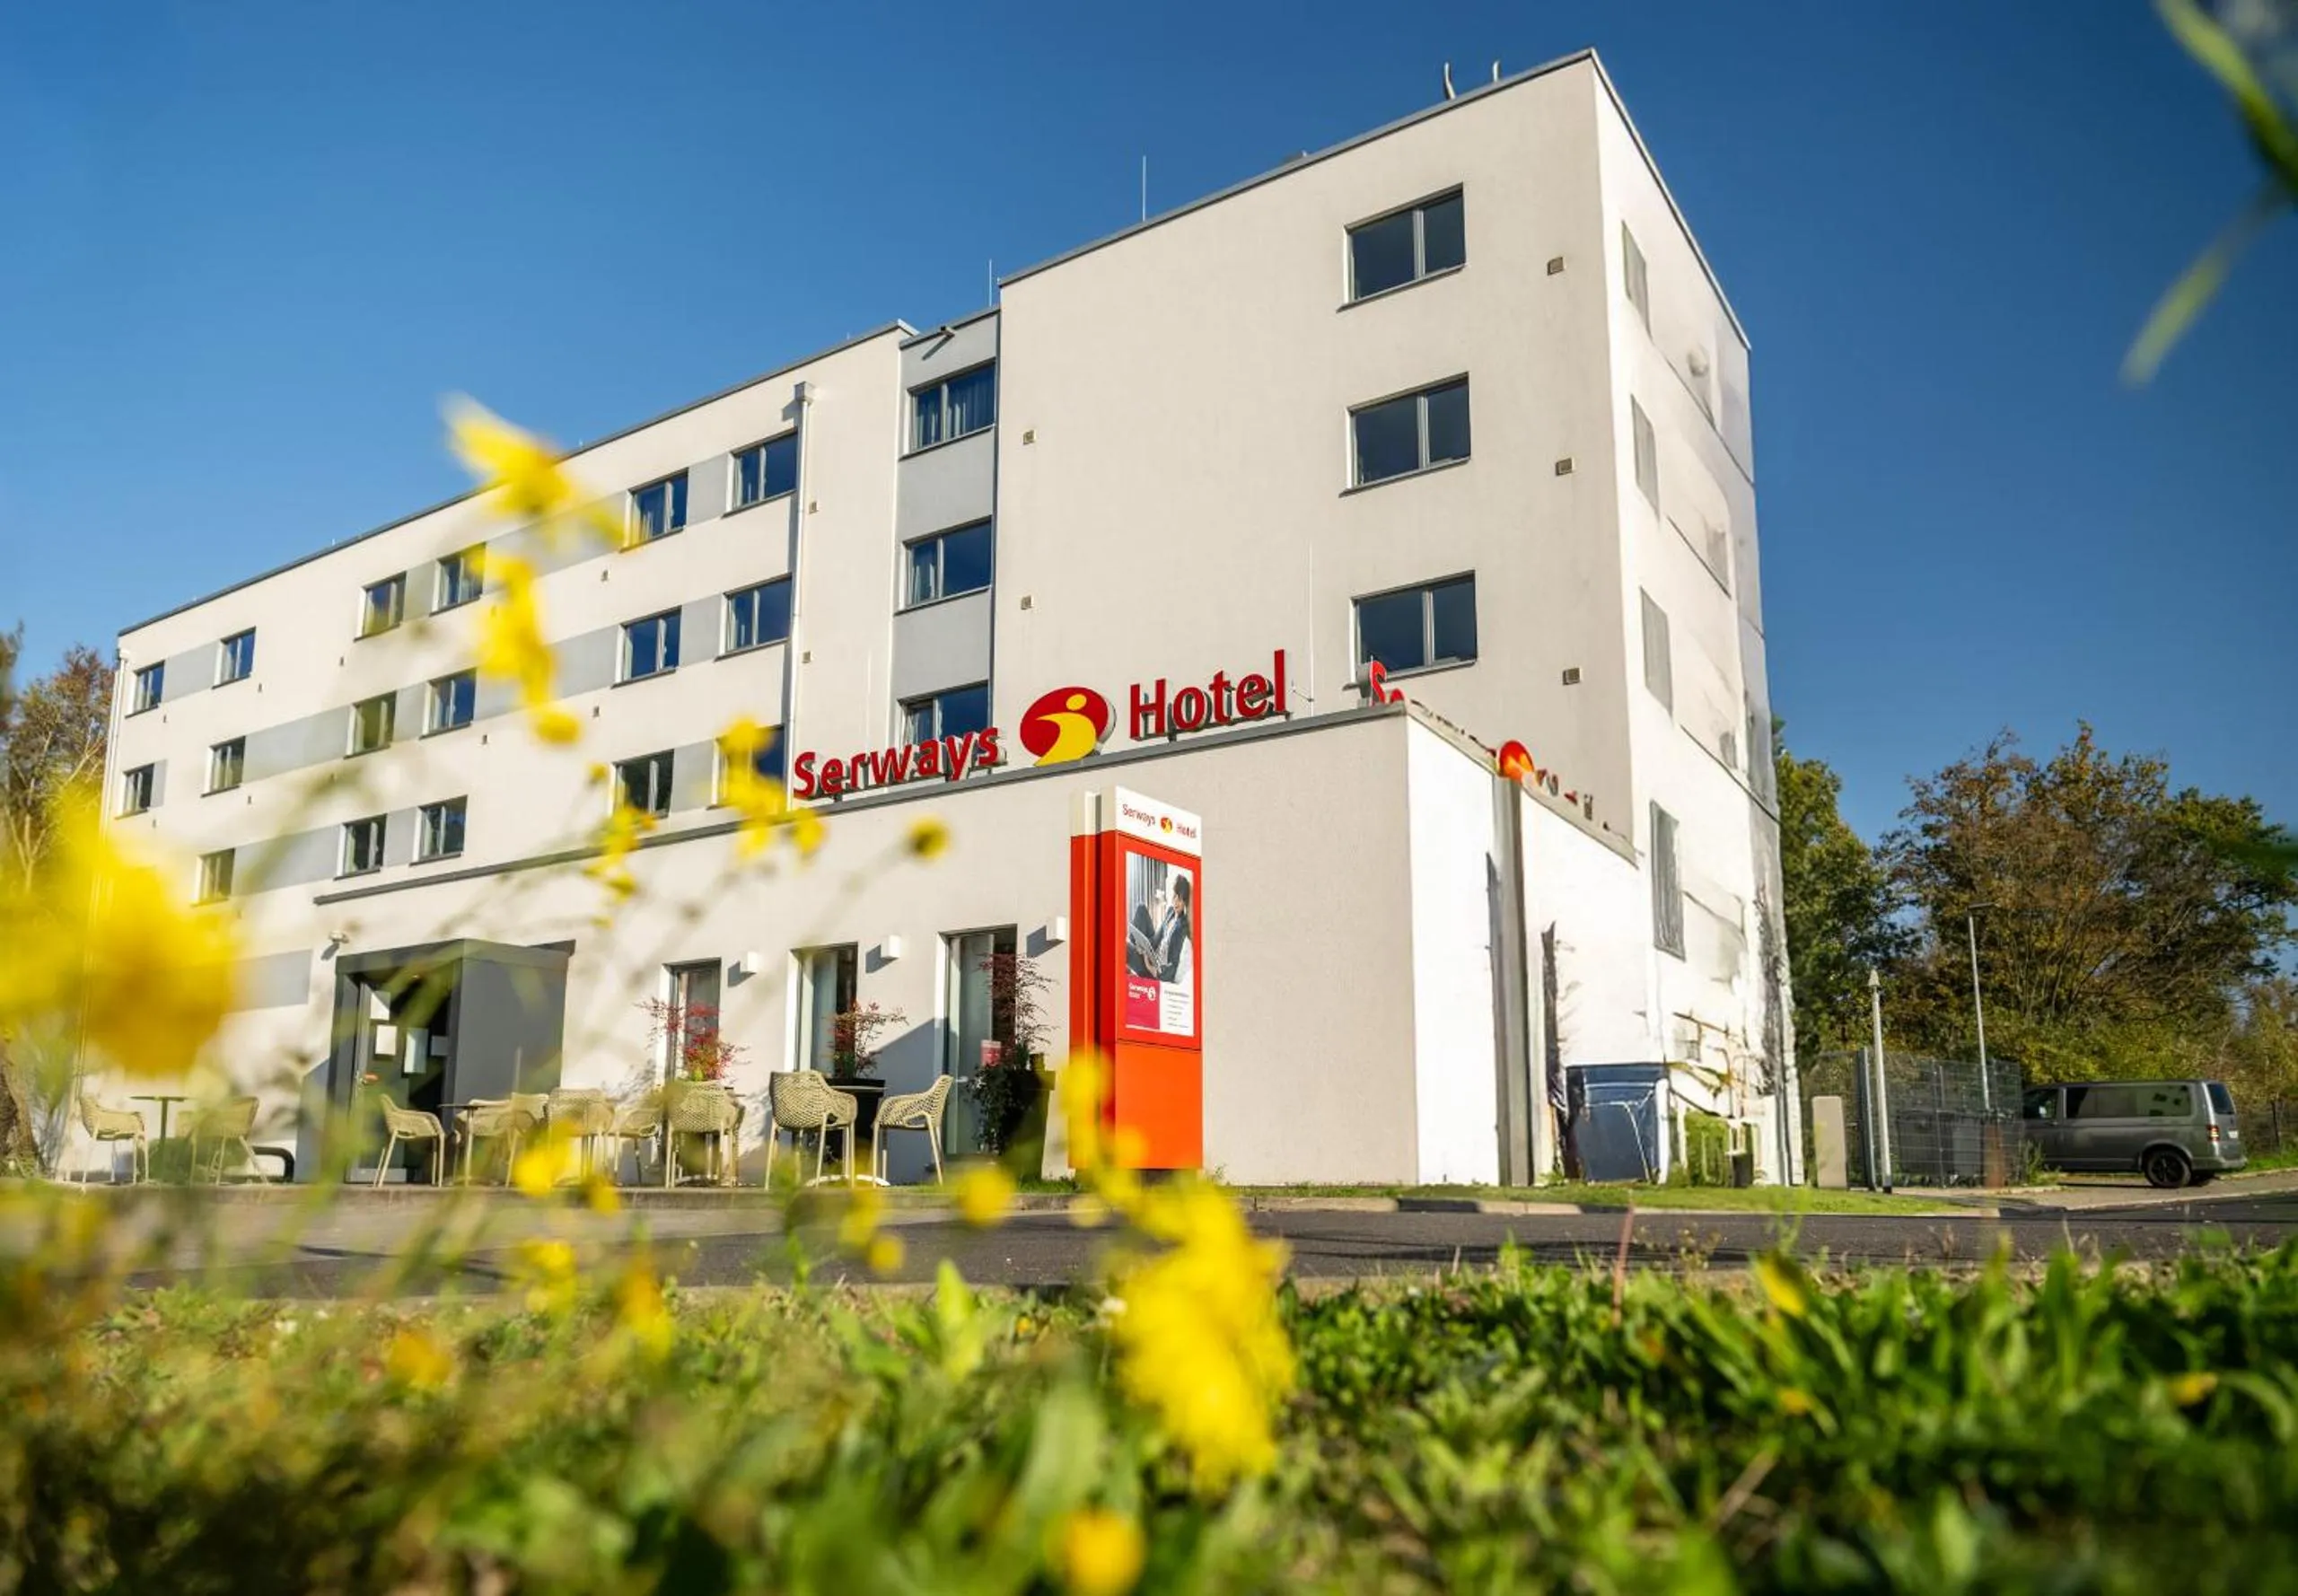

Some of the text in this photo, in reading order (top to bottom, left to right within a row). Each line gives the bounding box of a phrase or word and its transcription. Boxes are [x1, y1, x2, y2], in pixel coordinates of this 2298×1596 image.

[793, 725, 1003, 798] Serways
[1130, 648, 1287, 741] Hotel
[1122, 803, 1156, 827] Serways
